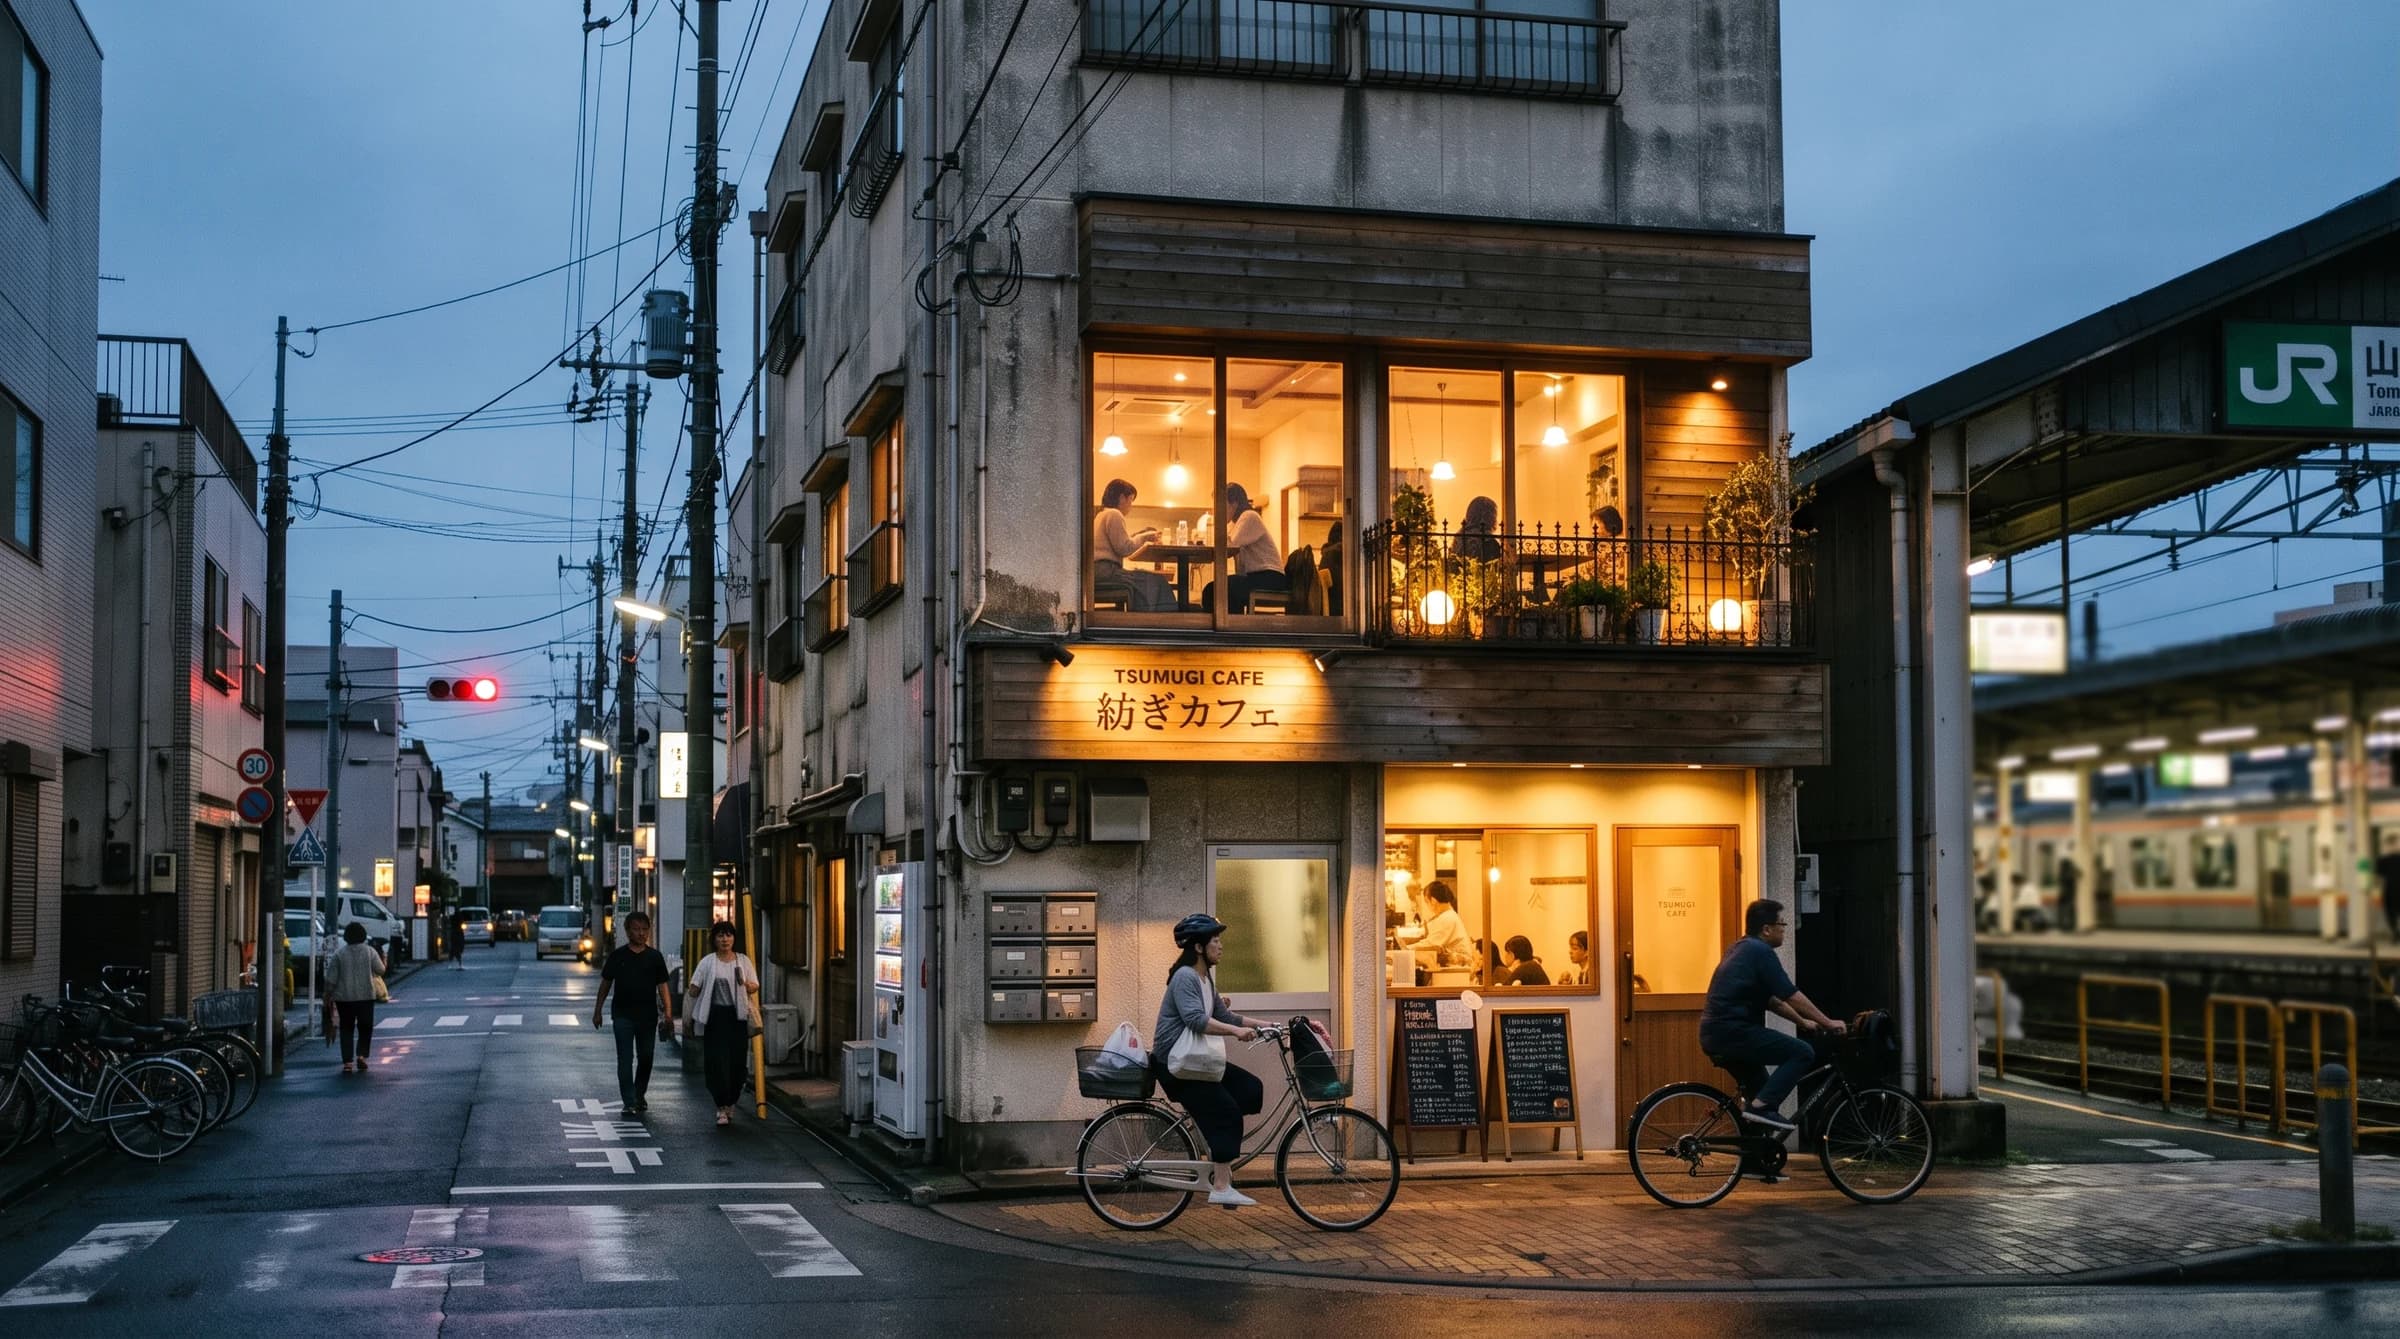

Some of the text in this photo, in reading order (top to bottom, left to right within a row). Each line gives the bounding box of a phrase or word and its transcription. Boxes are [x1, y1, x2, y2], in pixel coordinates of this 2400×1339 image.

[2239, 342, 2339, 405] JR
[1114, 669, 1264, 686] TSUMUGI CAFE
[1096, 691, 1280, 731] 紡ぎカフェ
[245, 757, 266, 774] 30
[1658, 901, 1696, 909] TSUMUGI
